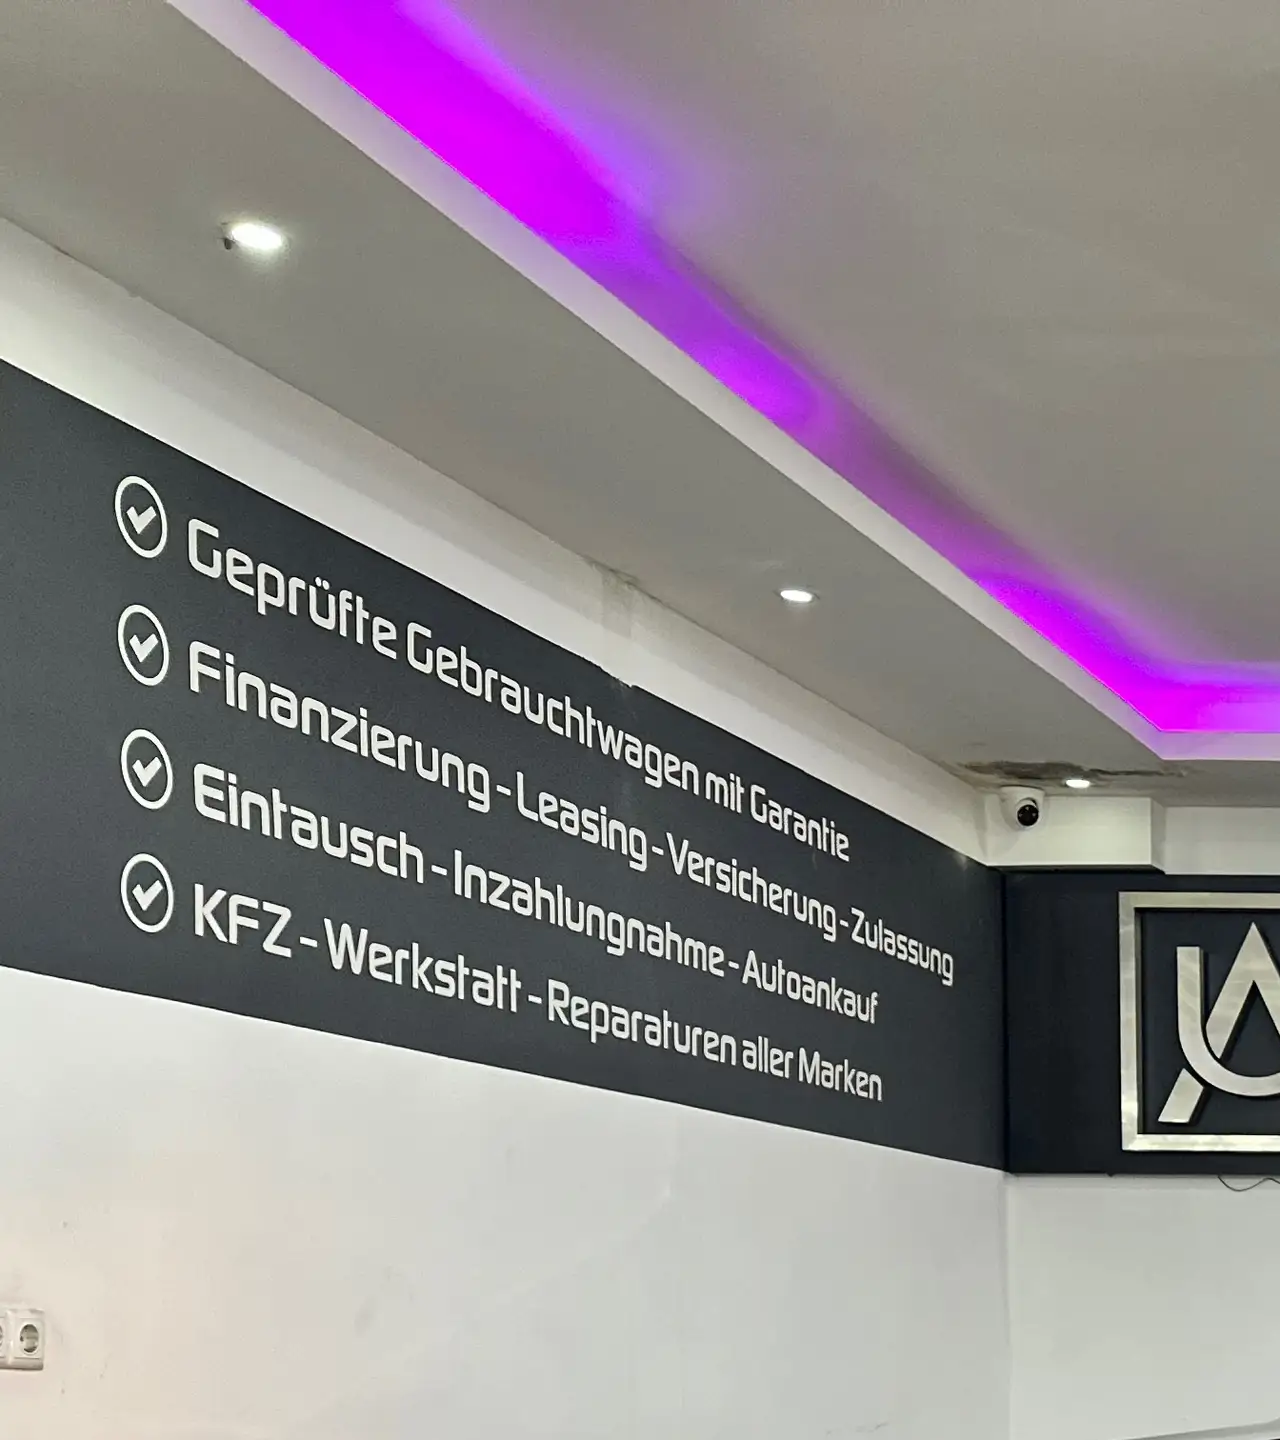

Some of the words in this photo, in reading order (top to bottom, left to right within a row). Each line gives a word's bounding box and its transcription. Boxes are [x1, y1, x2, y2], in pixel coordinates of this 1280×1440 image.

[189, 519, 397, 659] Geprüfte
[408, 623, 698, 795] Gebrauchtwagen
[706, 773, 744, 812] mit
[751, 785, 849, 861] Garantie
[190, 642, 490, 812] Finanzierung
[517, 772, 647, 871] Leasing
[667, 833, 836, 941] Versicherung
[852, 908, 953, 985] Zulassung
[194, 764, 423, 883] Eintausch
[455, 850, 724, 976] Inzahlungnahme
[743, 951, 877, 1023] Autoankauf
[195, 884, 291, 957] KFZ
[324, 918, 521, 1012] Werkstatt
[549, 980, 736, 1065] Reparaturen
[743, 1036, 793, 1078] aller
[799, 1048, 881, 1100] Marken
